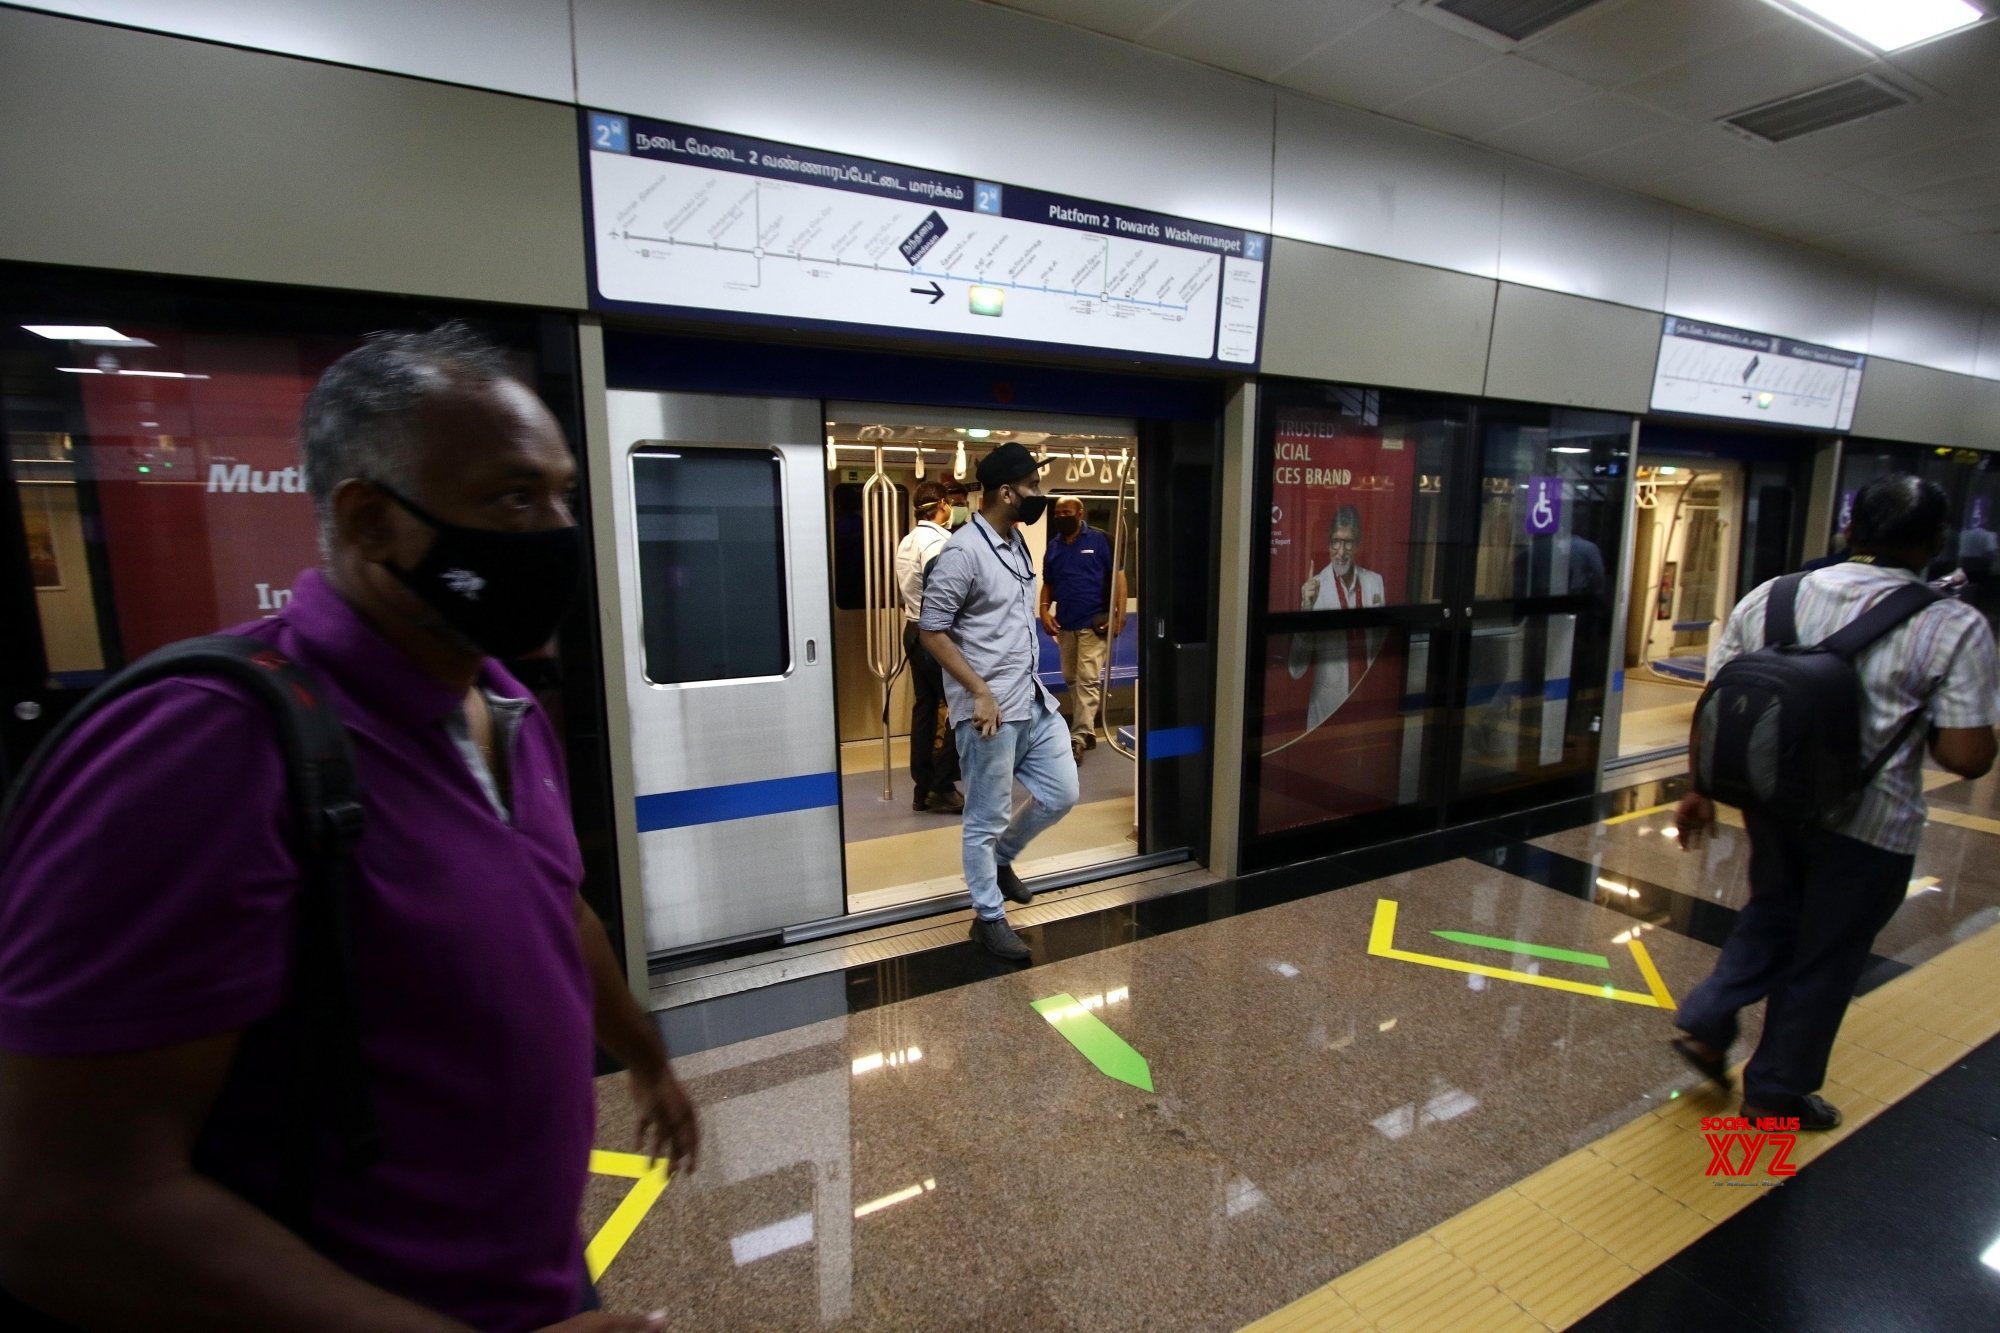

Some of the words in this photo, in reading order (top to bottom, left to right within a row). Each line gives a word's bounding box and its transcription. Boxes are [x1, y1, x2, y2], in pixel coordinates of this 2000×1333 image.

[636, 132, 745, 163] நடைமேடை
[749, 150, 759, 165] 2
[1049, 205, 1100, 227] Platform
[1102, 215, 1110, 228] 2
[1115, 216, 1160, 237] Towards
[1165, 226, 1241, 252] Washermanpet
[910, 234, 940, 263] Nandanam
[1280, 420, 1335, 439] TRUSTED
[1305, 467, 1352, 486] BRAND
